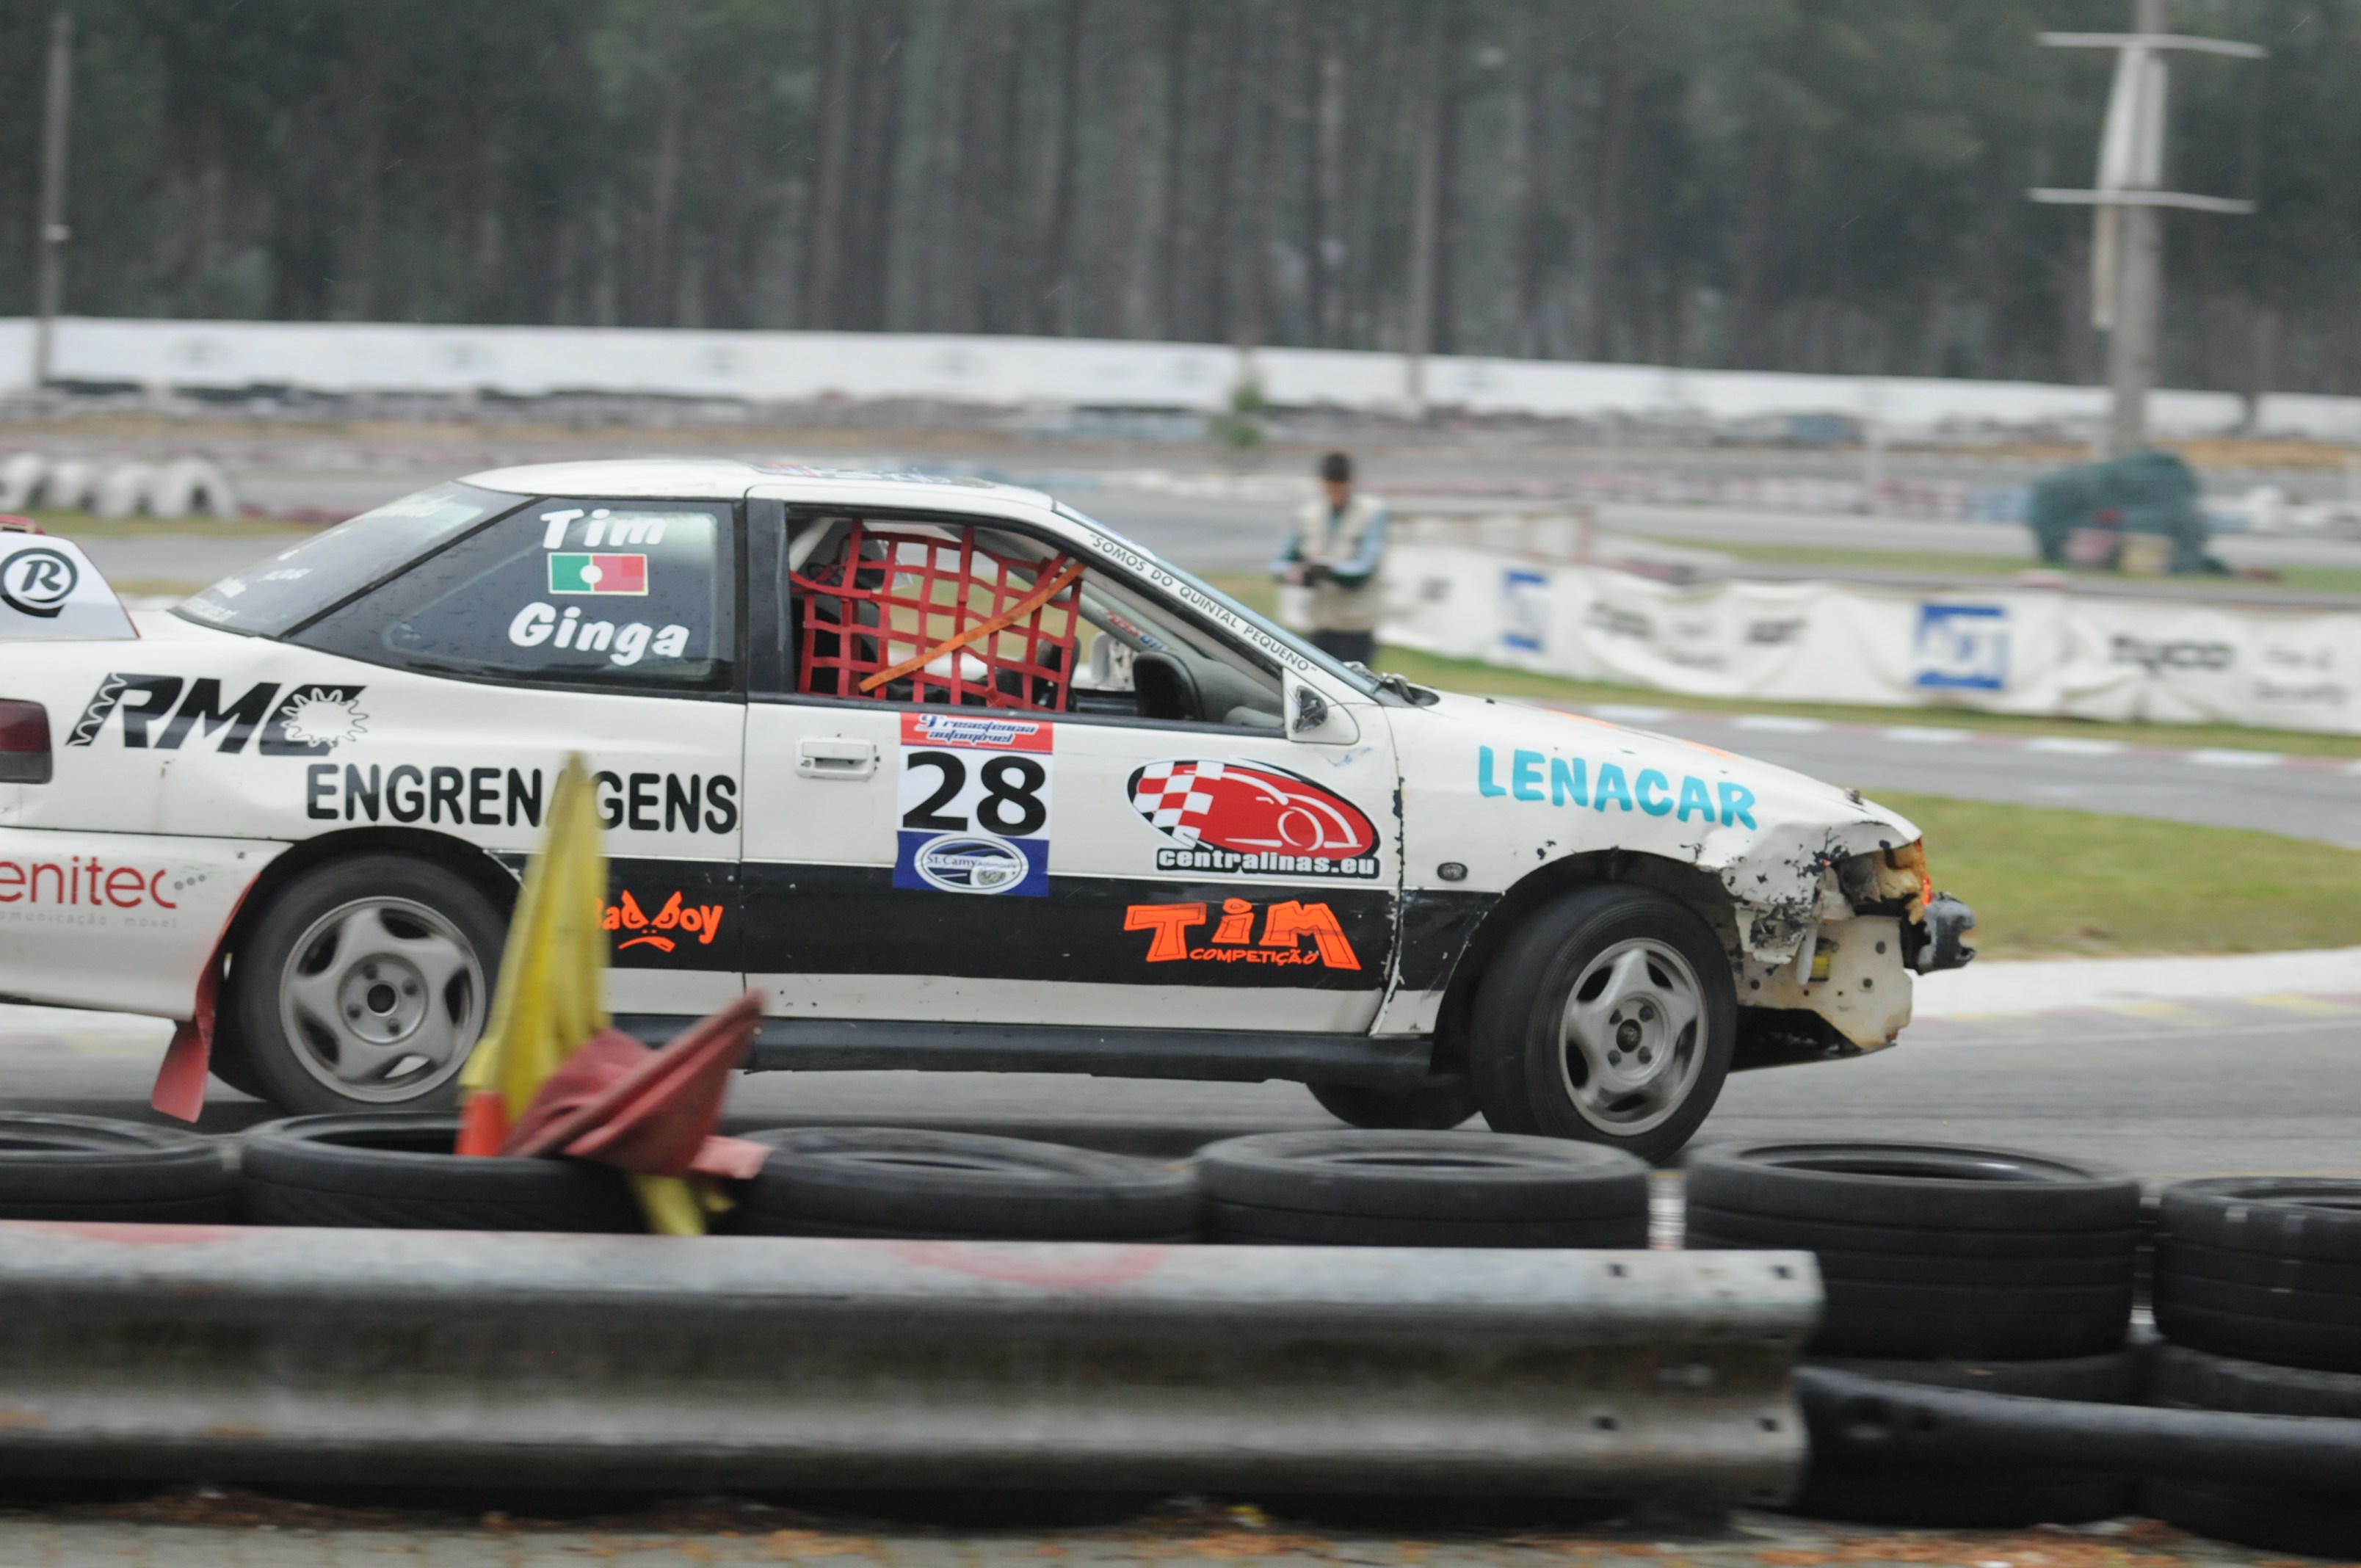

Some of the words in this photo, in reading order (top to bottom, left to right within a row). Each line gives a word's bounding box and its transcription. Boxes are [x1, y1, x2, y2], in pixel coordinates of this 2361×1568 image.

[540, 509, 667, 549] Tim
[1150, 568, 1174, 588] DO
[1179, 587, 1238, 628] QUINTAL
[508, 602, 689, 666] Ginga
[65, 672, 369, 756] RMC
[307, 763, 738, 834] ENGRENGENS
[902, 751, 1046, 836] 28
[1479, 746, 1757, 830] LENACAR
[1158, 848, 1376, 875] centralinas.eu
